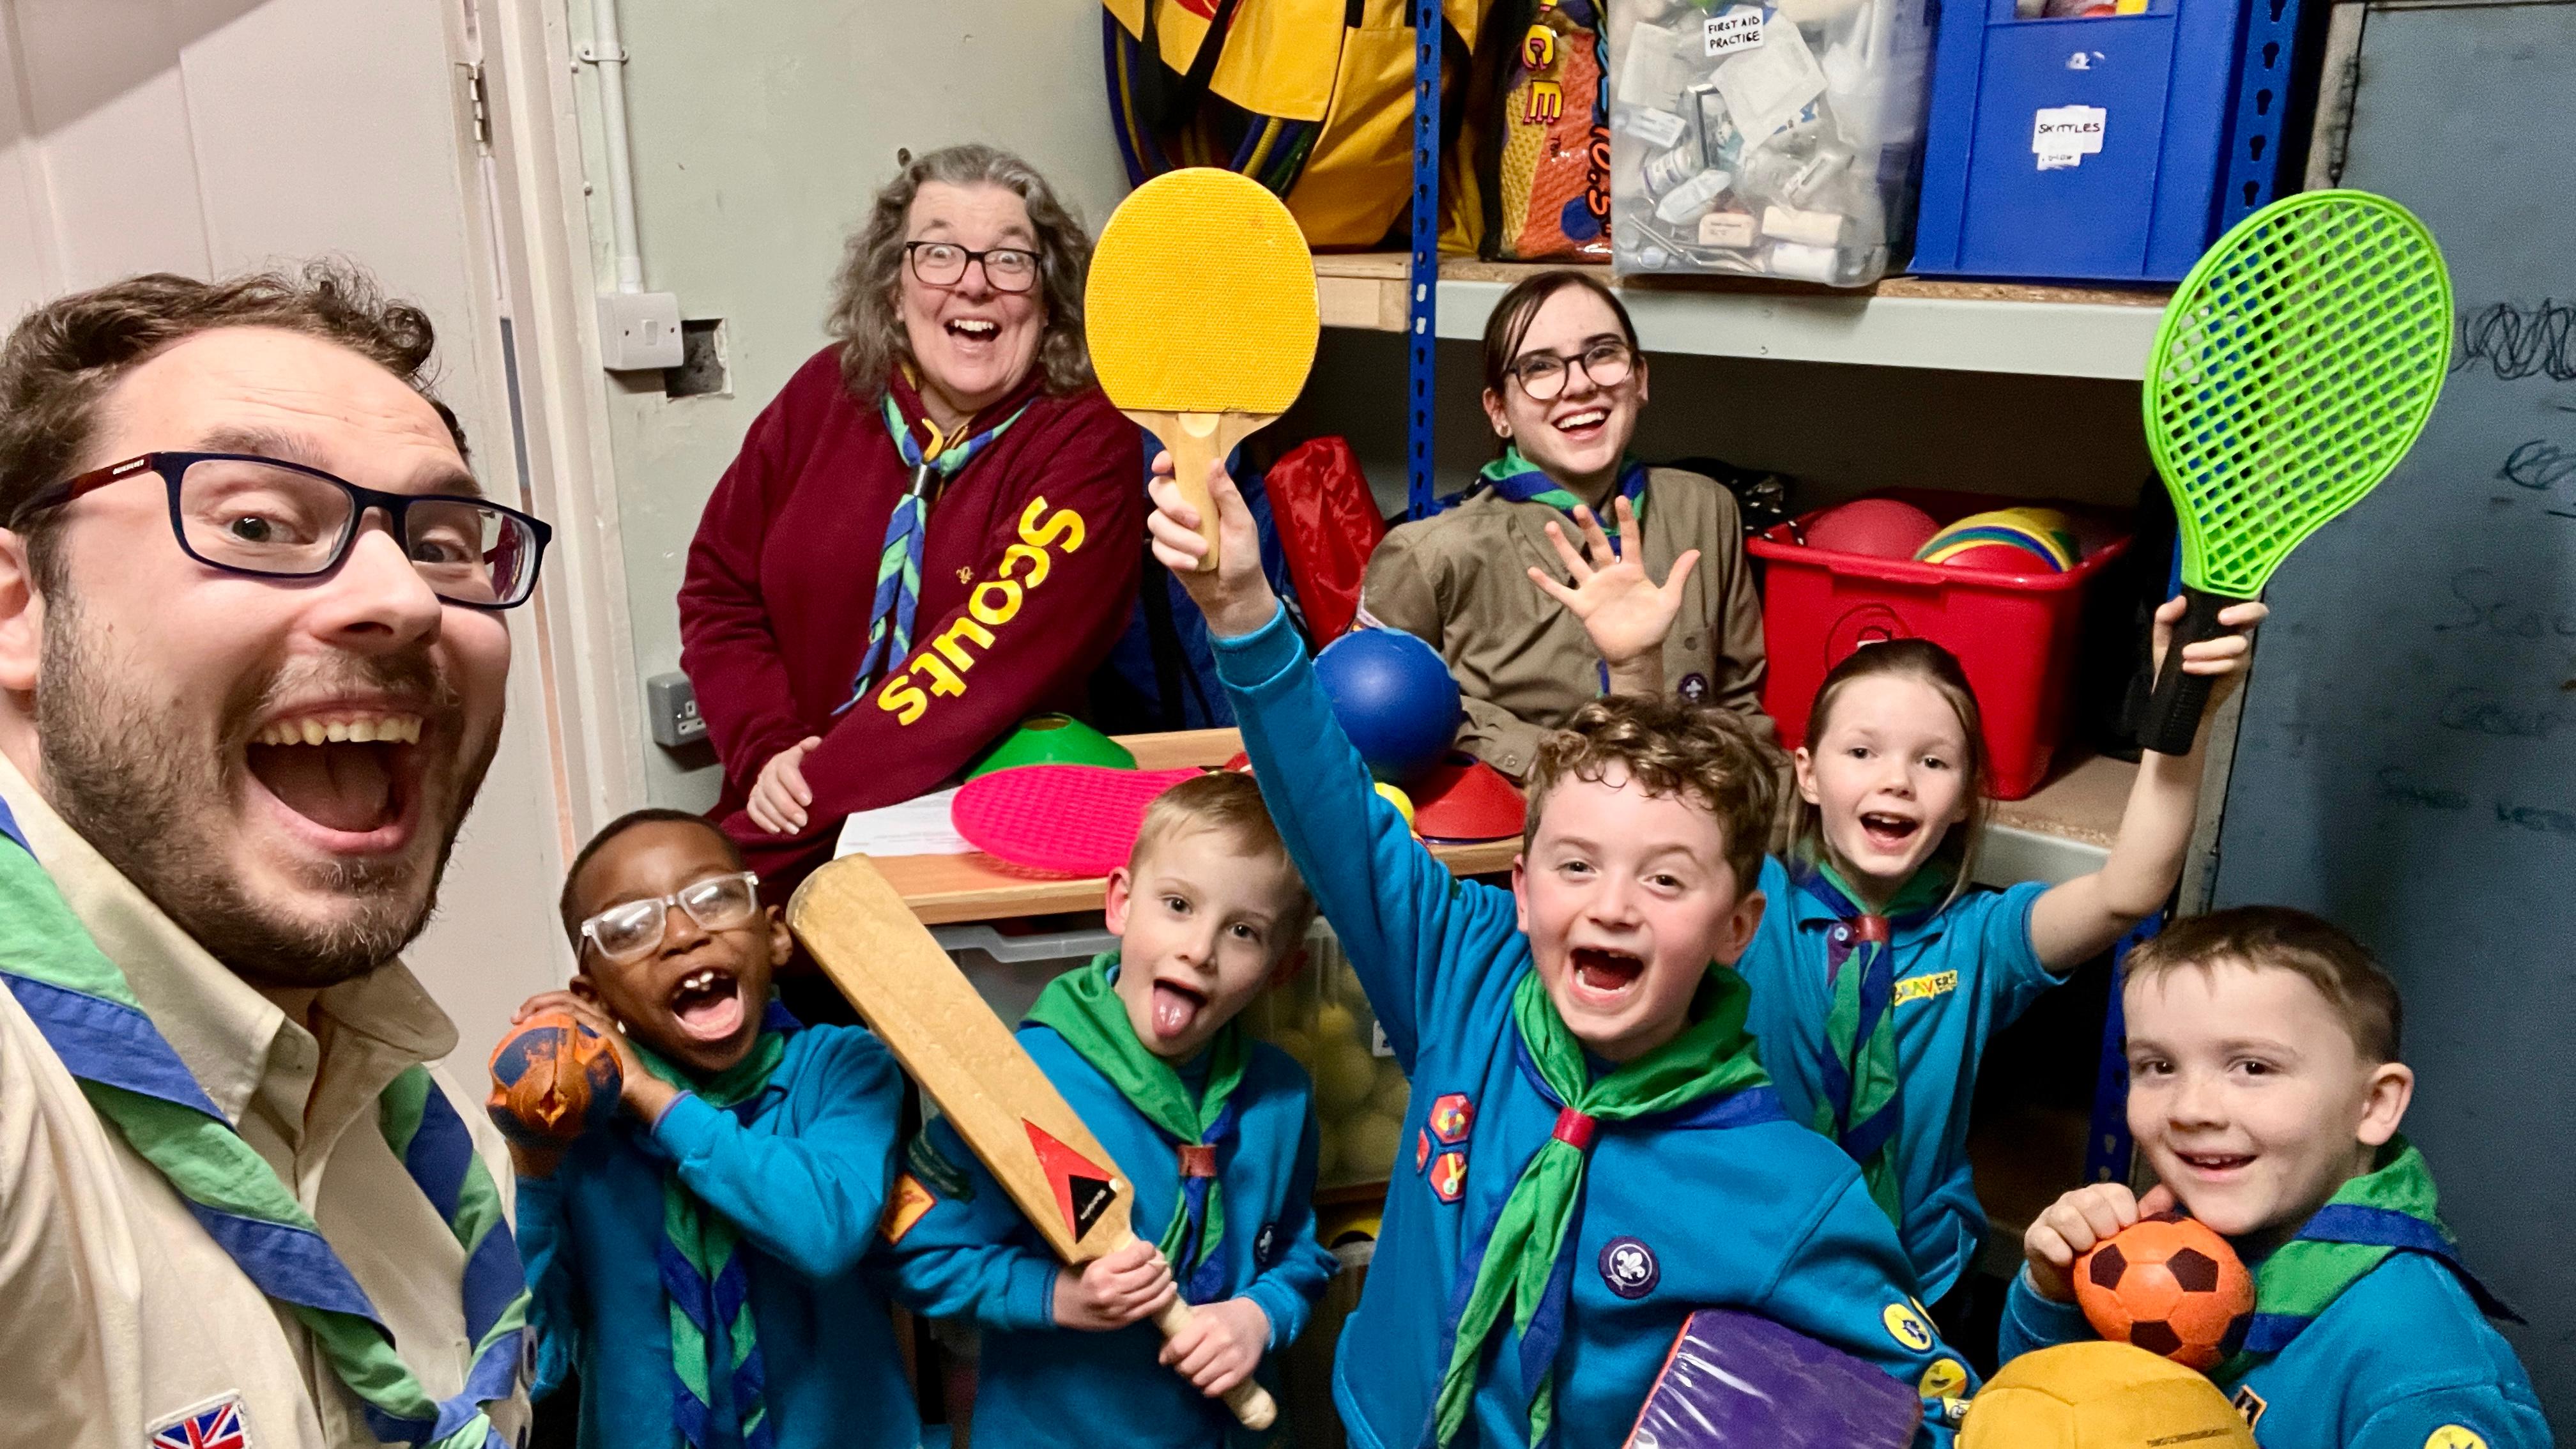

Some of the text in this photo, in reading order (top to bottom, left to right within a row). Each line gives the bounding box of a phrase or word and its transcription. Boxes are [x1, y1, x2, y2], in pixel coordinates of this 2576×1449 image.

[1708, 16, 1760, 34] FIRST AID
[2039, 123, 2101, 134] SKITTLES
[878, 496, 1085, 726] Scouts
